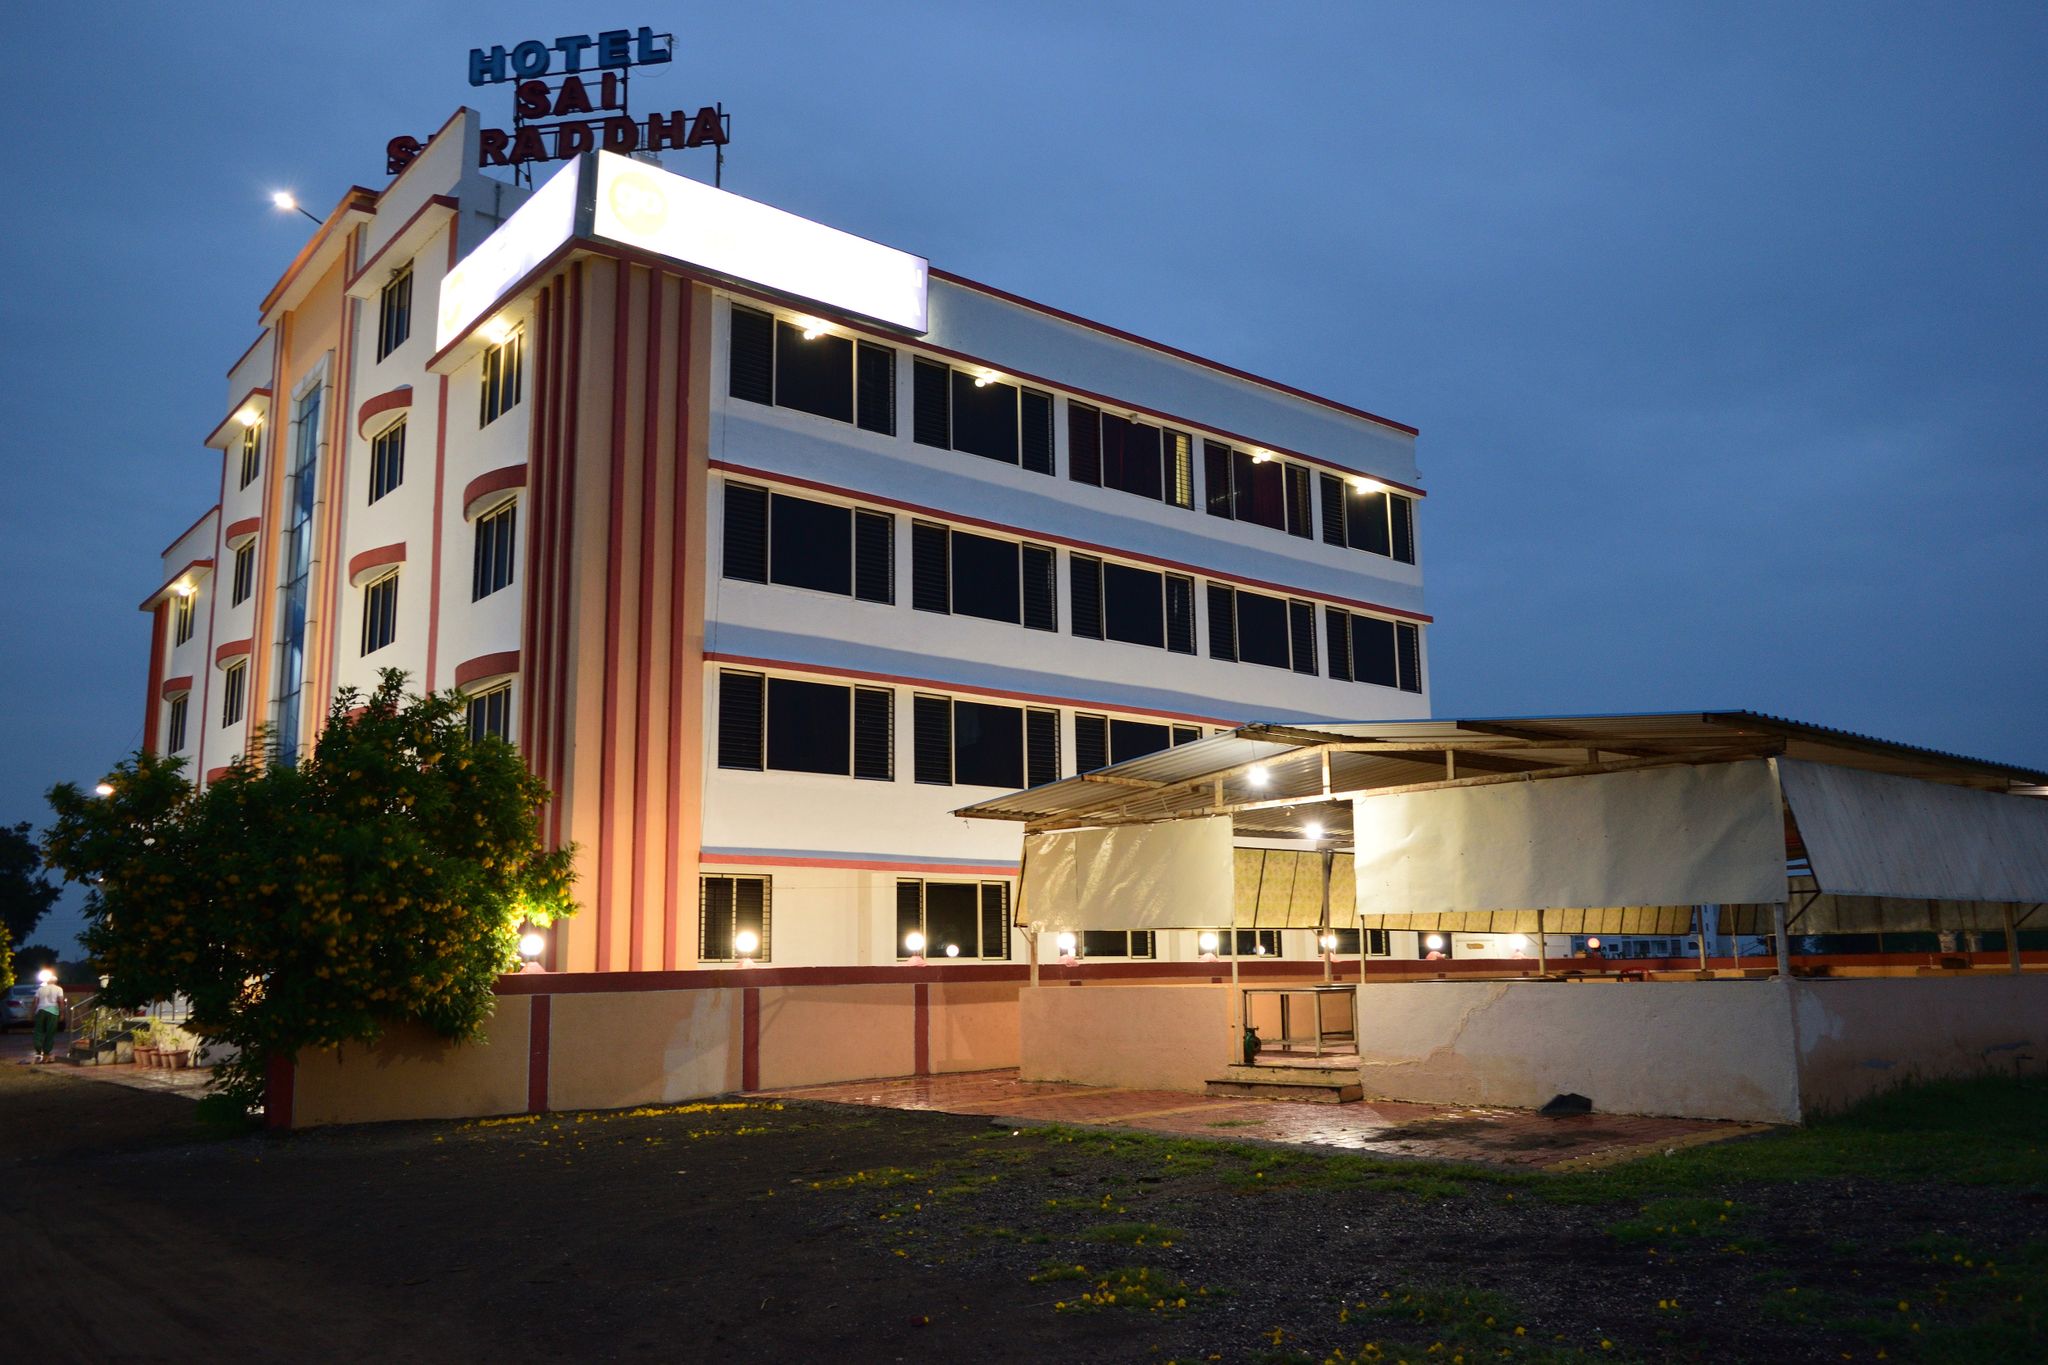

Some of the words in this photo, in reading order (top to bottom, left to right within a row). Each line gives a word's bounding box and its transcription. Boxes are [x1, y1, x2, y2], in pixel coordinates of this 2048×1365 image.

[468, 26, 669, 86] HOTEL
[517, 72, 617, 120] SAI
[386, 107, 727, 174] SRADDHA
